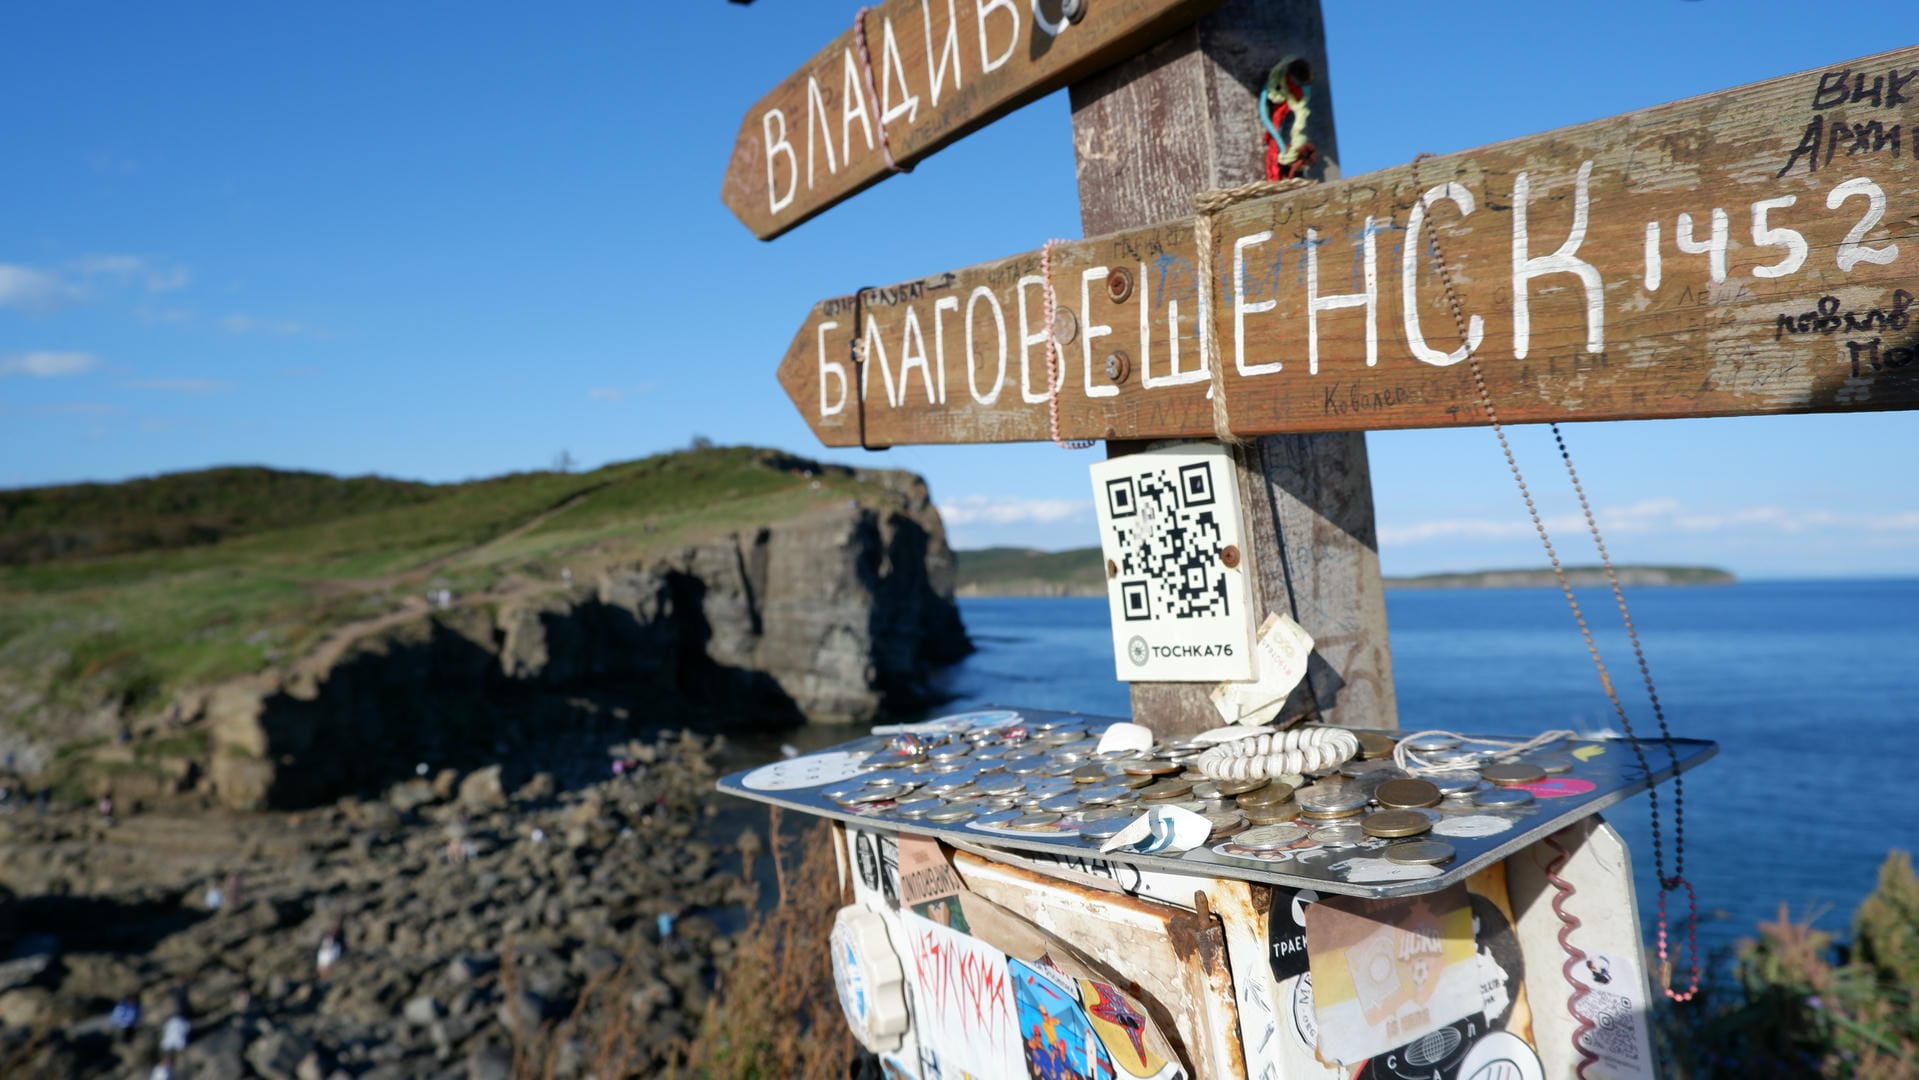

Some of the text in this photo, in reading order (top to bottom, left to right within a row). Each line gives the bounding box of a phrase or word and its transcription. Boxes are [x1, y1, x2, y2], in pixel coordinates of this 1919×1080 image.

[817, 159, 1606, 417] БЛАГОВЕЩЕНСК
[1643, 176, 1900, 292] 1452
[1152, 643, 1234, 659] TOCHKA76
